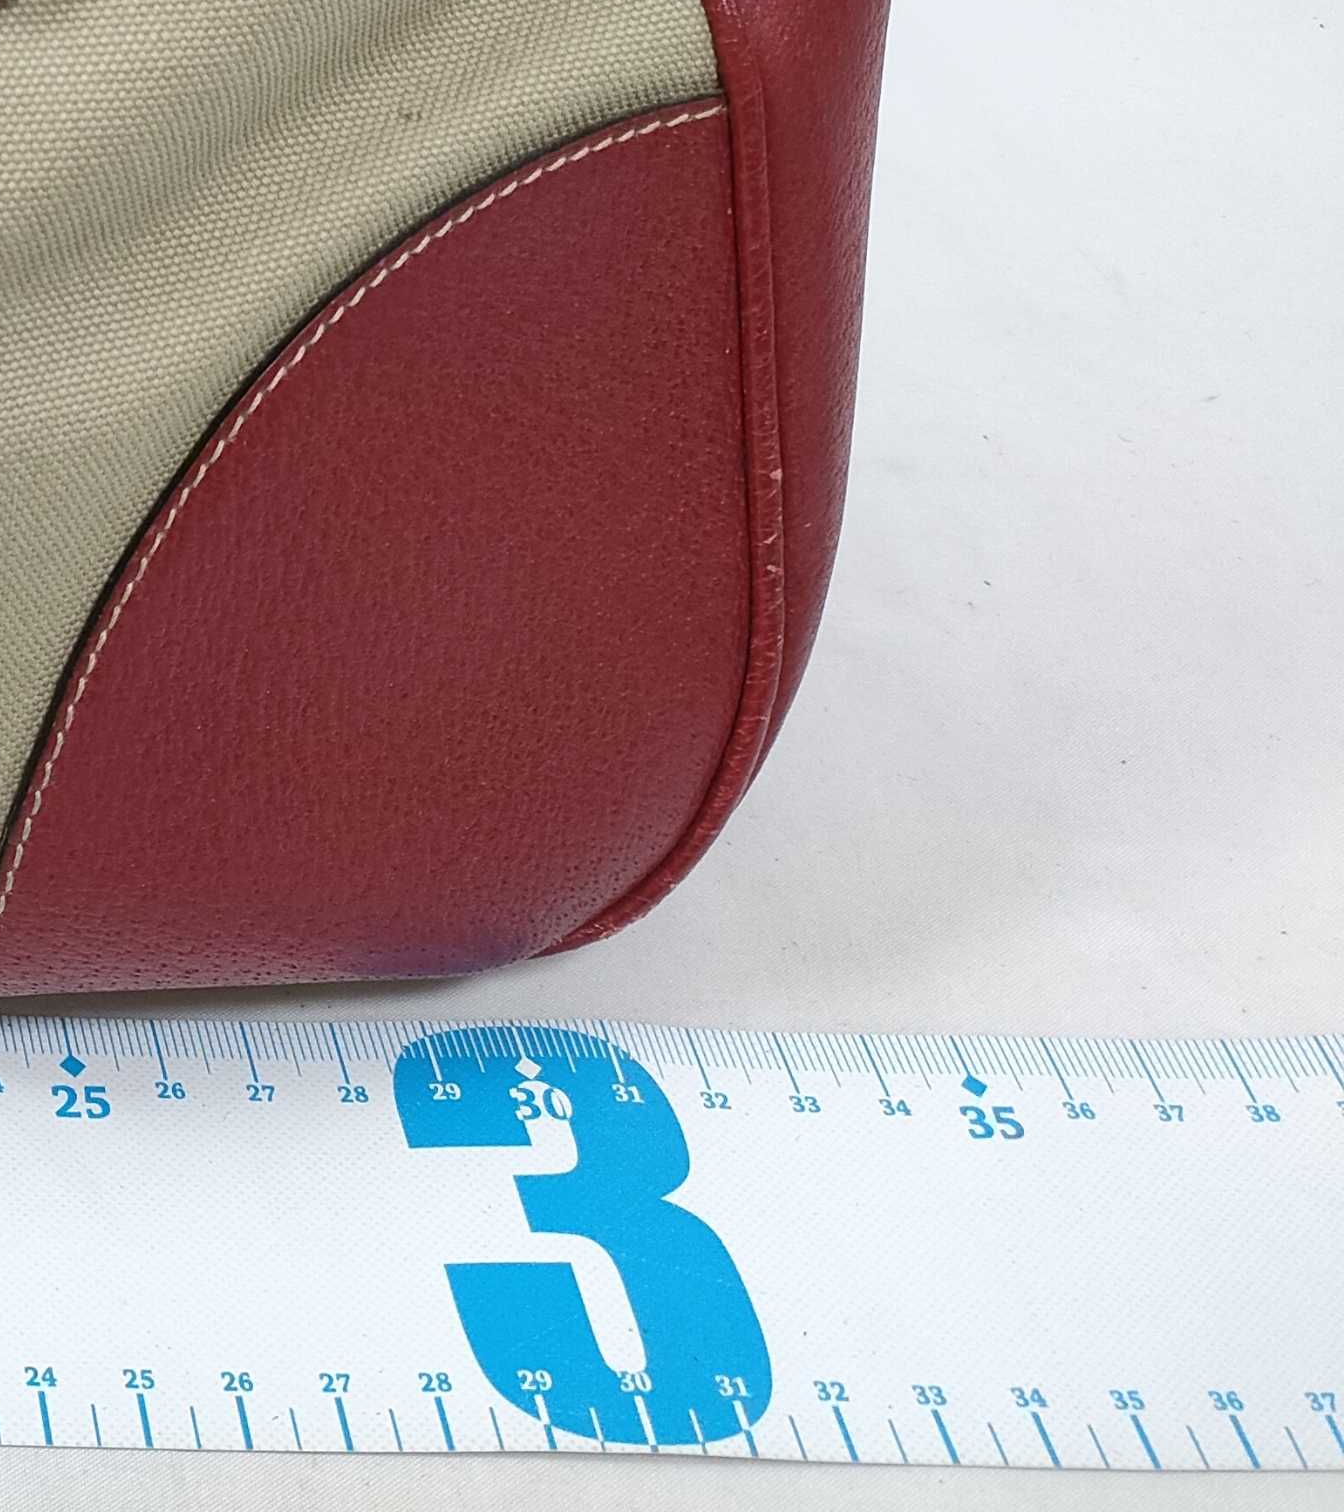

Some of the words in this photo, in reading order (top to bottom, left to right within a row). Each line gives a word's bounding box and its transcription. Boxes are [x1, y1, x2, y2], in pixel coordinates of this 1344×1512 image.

[51, 1086, 112, 1119] 25
[155, 1081, 186, 1100] 26
[246, 1084, 275, 1102] 27
[337, 1085, 369, 1103] 28
[428, 1083, 461, 1101] 29
[509, 1086, 573, 1121] 30
[612, 1084, 645, 1104] 31
[699, 1091, 732, 1110] 32
[789, 1095, 822, 1114] 33
[878, 1099, 912, 1117] 34
[959, 1105, 1025, 1139] 35
[1062, 1102, 1096, 1121] 36
[1153, 1104, 1185, 1123] 37
[1245, 1105, 1282, 1123] 38
[393, 1025, 773, 1446] 3
[23, 1367, 57, 1388] 24
[122, 1369, 155, 1389] 25
[221, 1372, 254, 1392] 26
[318, 1374, 351, 1393] 27
[418, 1373, 452, 1393] 28
[517, 1370, 552, 1391] 29
[616, 1372, 652, 1393] 30
[715, 1376, 751, 1398] 31
[813, 1382, 850, 1403] 32
[911, 1385, 948, 1406] 33
[1010, 1388, 1048, 1409] 34
[1109, 1390, 1144, 1411] 35
[1208, 1391, 1244, 1412] 36
[1305, 1393, 1337, 1414] 37
